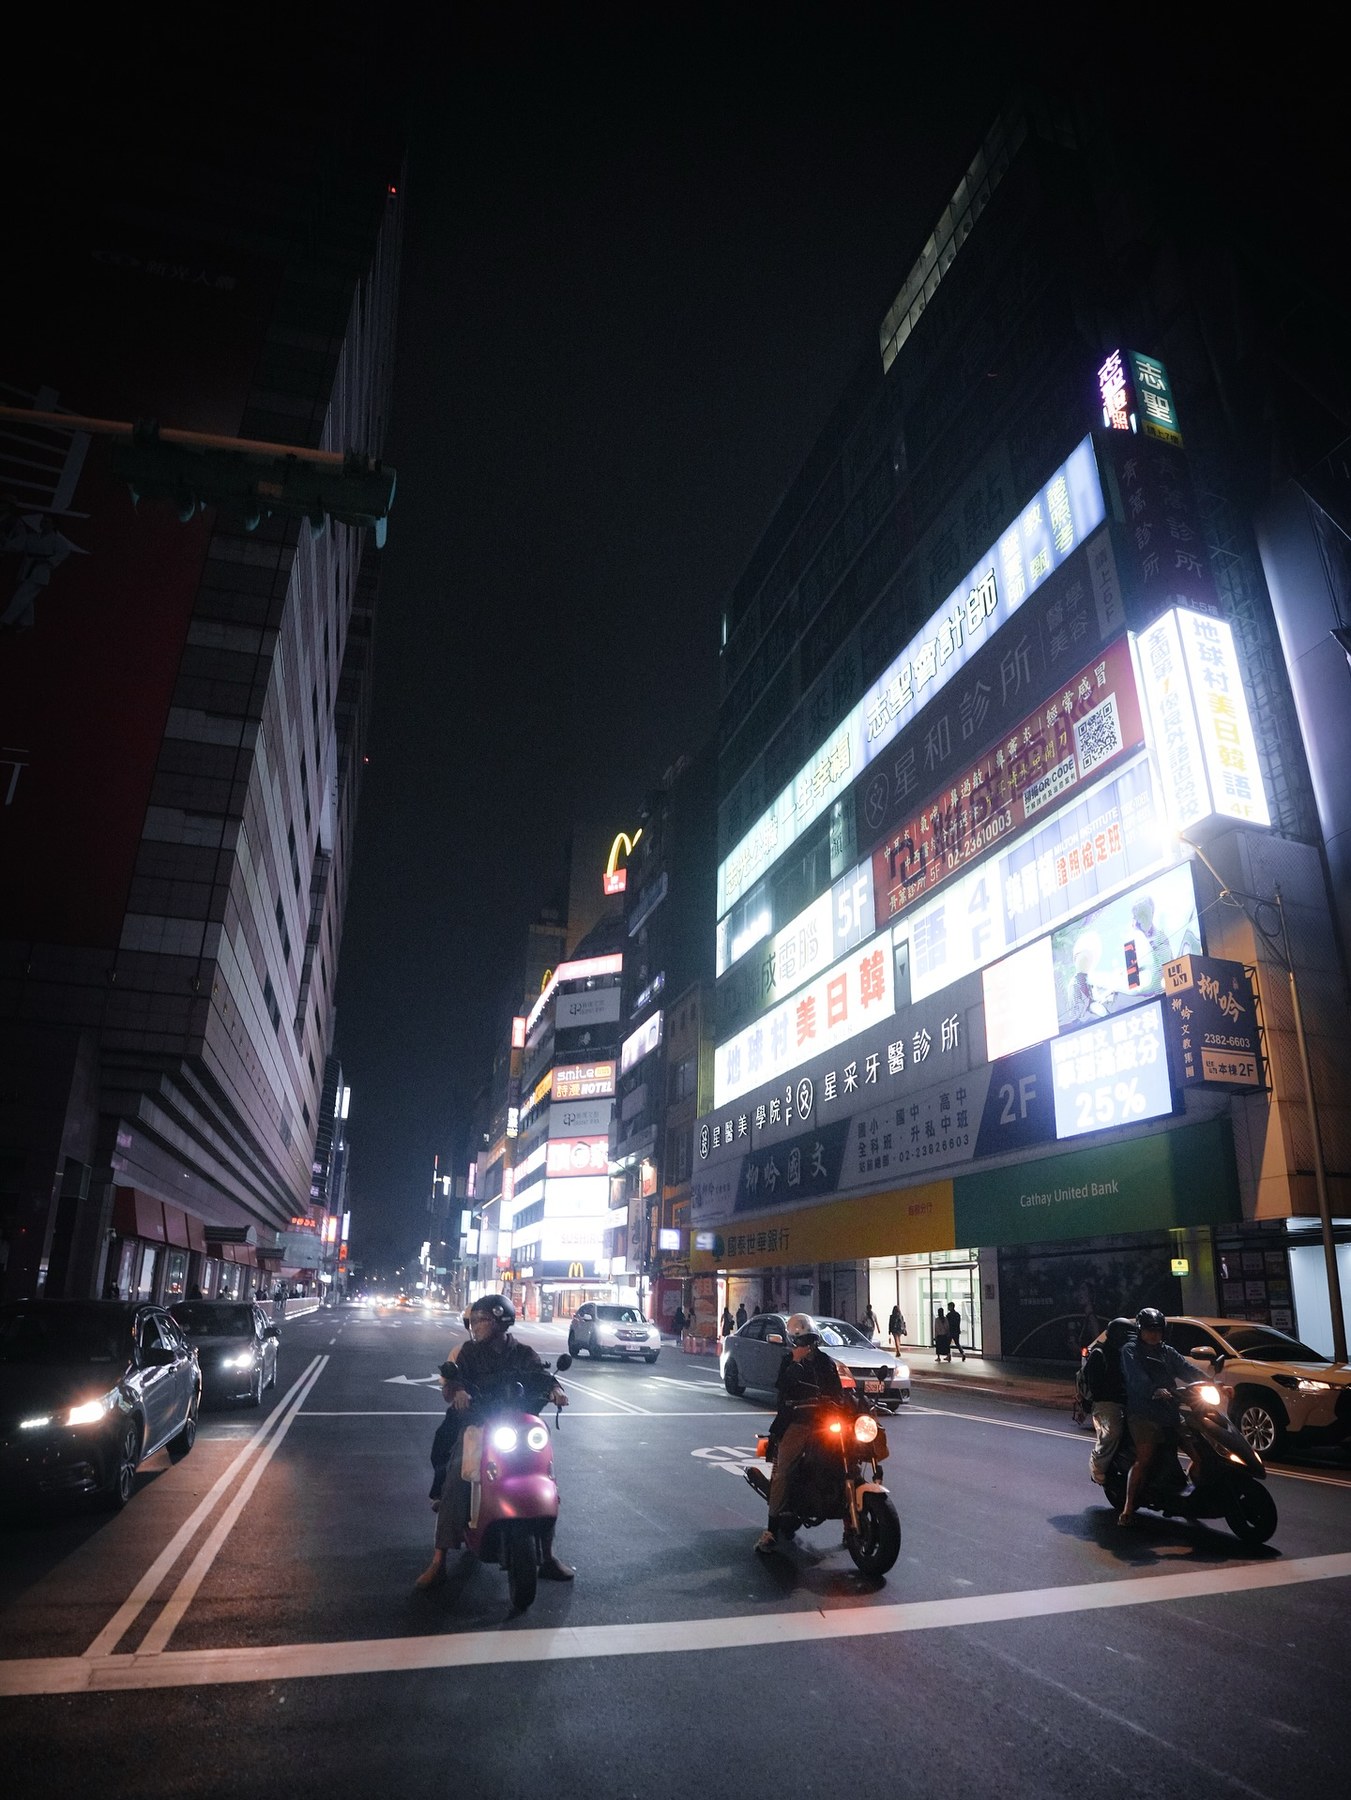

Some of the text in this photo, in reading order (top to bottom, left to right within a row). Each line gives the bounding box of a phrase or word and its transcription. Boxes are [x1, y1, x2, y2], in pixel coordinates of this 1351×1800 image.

[1136, 360, 1173, 424] 志聖
[866, 568, 998, 742] 志聖會計師
[1049, 608, 1088, 663] 美容
[894, 634, 1032, 805] 星和診所
[1046, 661, 1106, 728] 經常感冒
[1192, 617, 1255, 818] 地球村美日韓語 4F
[1051, 759, 1075, 783] CODE
[930, 862, 941, 883] 5F
[947, 809, 1013, 870] 02-23610003
[837, 873, 869, 939] 5F
[727, 949, 886, 1086] 地球村美日韓
[913, 904, 947, 981] 語
[967, 876, 991, 961] 4F
[1197, 972, 1246, 1023] 柳吟
[823, 1013, 960, 1103] 星采牙醫診所
[1171, 998, 1195, 1079] 柳吟文教集團
[1204, 1033, 1251, 1048] 2382-6603
[711, 1084, 793, 1150] 星醫美學院 3F
[999, 1074, 1037, 1123] 2F
[1075, 1076, 1147, 1128] 25%
[745, 1141, 828, 1194] 柳吟國文
[1020, 1179, 1119, 1207] Cathay United Bank
[727, 1228, 790, 1257] 國泰世華銀行
